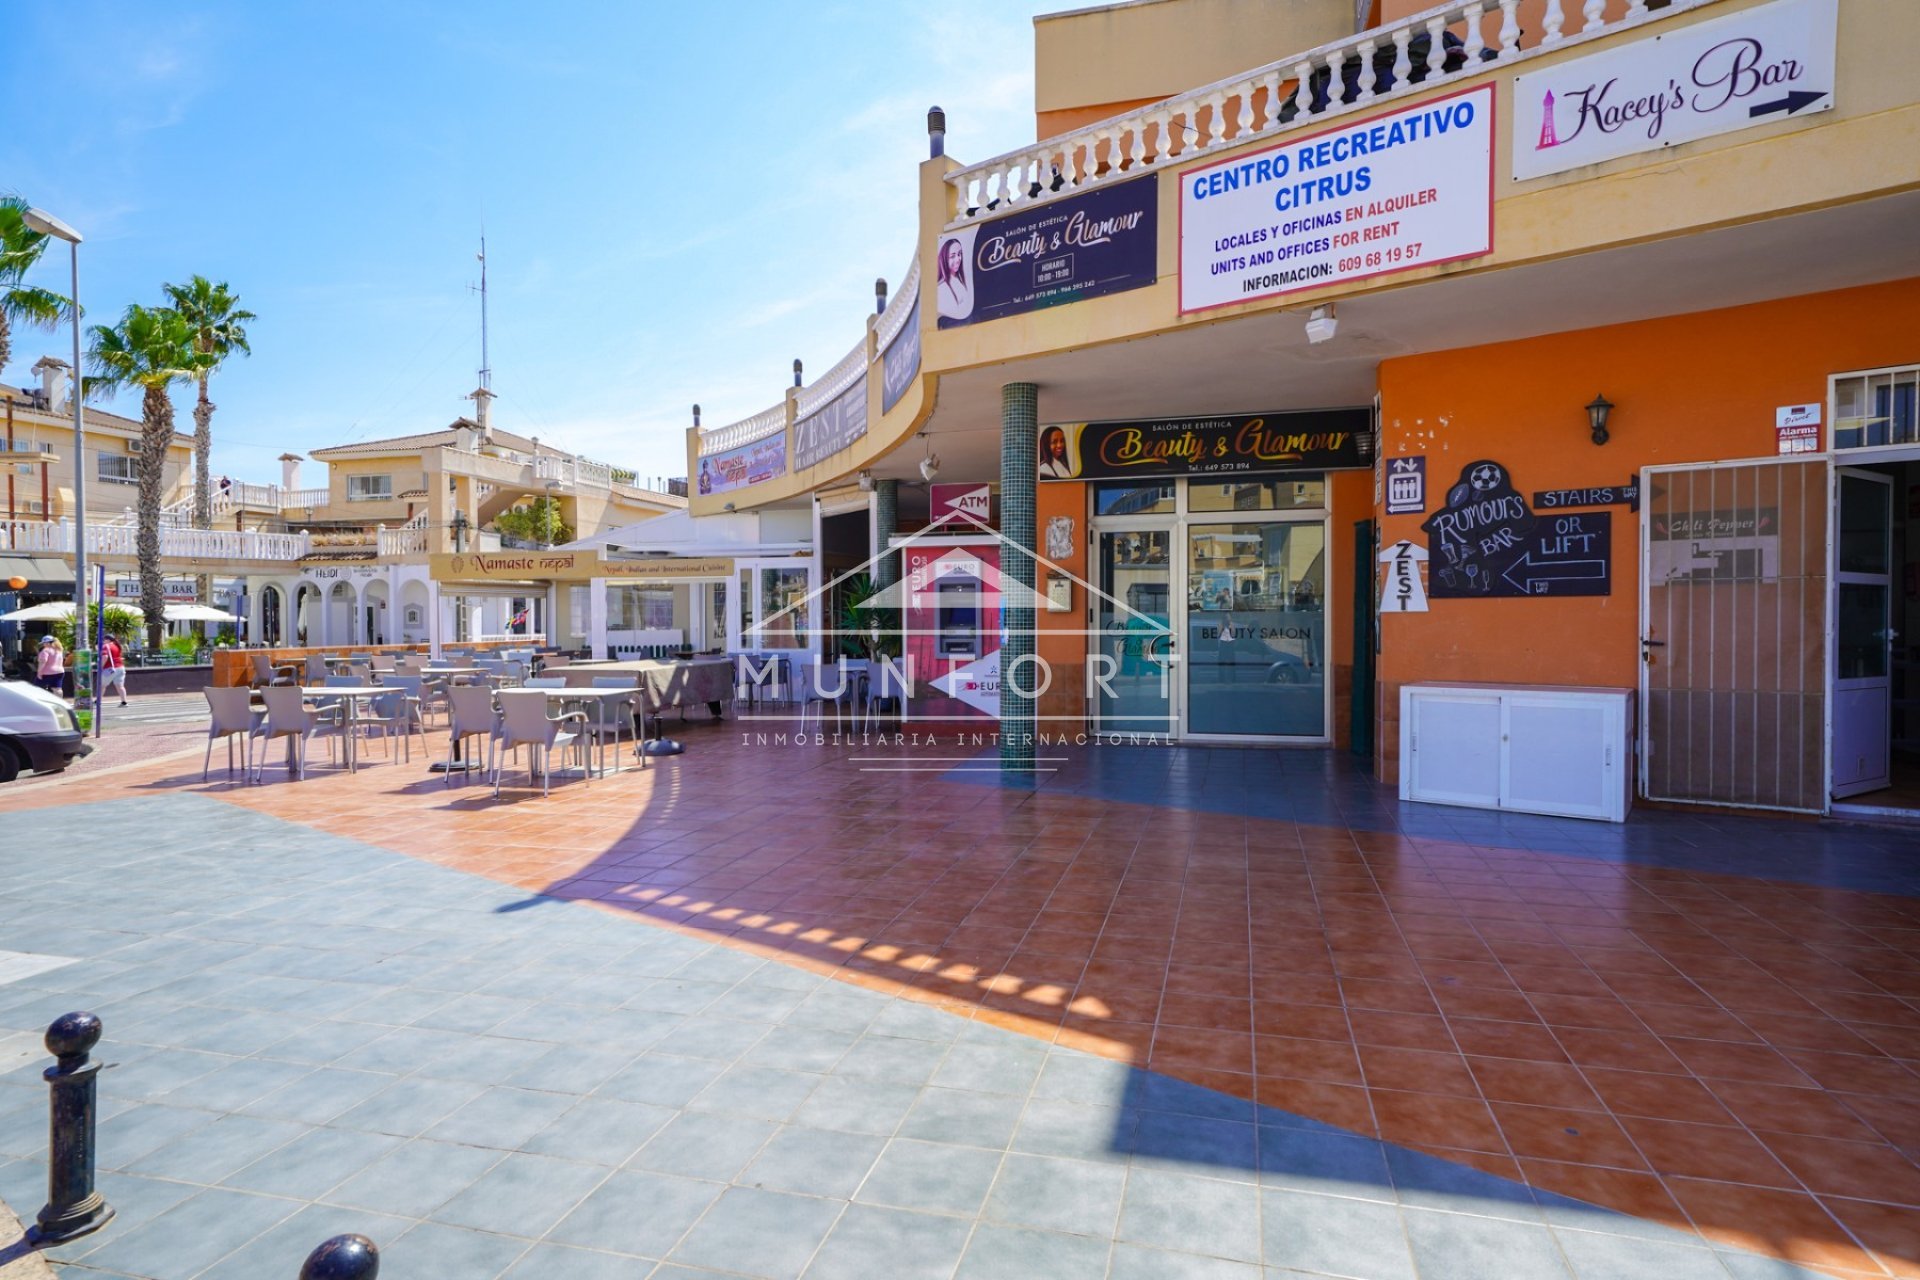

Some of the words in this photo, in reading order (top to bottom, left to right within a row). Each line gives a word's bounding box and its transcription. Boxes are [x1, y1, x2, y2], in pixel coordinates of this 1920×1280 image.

[1559, 78, 1684, 144] Kacey's
[1691, 37, 1804, 113] Bar
[1193, 154, 1290, 200] CENTRO
[1298, 101, 1475, 172] RECREATIVO
[1275, 166, 1372, 212] CITRUS
[1005, 226, 1027, 238] SALÓN
[1028, 224, 1037, 232] DE
[1038, 214, 1069, 229] ESTÉTICA
[1215, 230, 1267, 252] LOCALES
[1270, 225, 1279, 239] Y
[1282, 210, 1342, 236] OFICINAS
[1345, 205, 1363, 222] EN
[1367, 187, 1438, 218] ALQUILER
[977, 231, 1047, 271] Beauty
[1050, 231, 1061, 251] &
[1064, 210, 1144, 247] Glamour
[1211, 257, 1246, 276] UNITS
[1249, 250, 1275, 268] AND
[1277, 237, 1330, 261] OFFICES
[1333, 231, 1360, 249] FOR
[1363, 221, 1400, 243] RENT
[1041, 259, 1066, 272] HORARIO
[1243, 262, 1333, 293] INFORMACION:
[1338, 254, 1362, 273] 609
[1365, 250, 1382, 267] 68
[1386, 246, 1401, 263] 19
[1406, 242, 1422, 259] 57
[1152, 422, 1179, 432] SALÓN
[1182, 421, 1193, 431] DE
[1195, 419, 1233, 430] ESTÉTICA
[1779, 427, 1817, 437] Alarma
[1099, 428, 1207, 467] Beauty
[1214, 436, 1229, 457] &
[1235, 419, 1350, 460] Glamour
[1205, 463, 1219, 472] 649
[1220, 463, 1234, 471] 573
[1236, 462, 1250, 470] 894
[958, 496, 988, 508] ATM
[1543, 487, 1614, 506] STAIRS
[1555, 517, 1582, 534] OR
[1670, 520, 1702, 532] Chli
[1479, 527, 1524, 557] BAR
[1541, 533, 1595, 555] LIFT
[470, 554, 534, 574] Namaste
[540, 554, 576, 573] nepal
[911, 556, 921, 591] EURO
[1396, 543, 1412, 611] ZEST
[122, 583, 140, 593] TH
[172, 585, 193, 594] BAR
[1202, 627, 1256, 640] BEAUTY
[1259, 627, 1312, 640] SALON
[980, 682, 1000, 691] EUR
